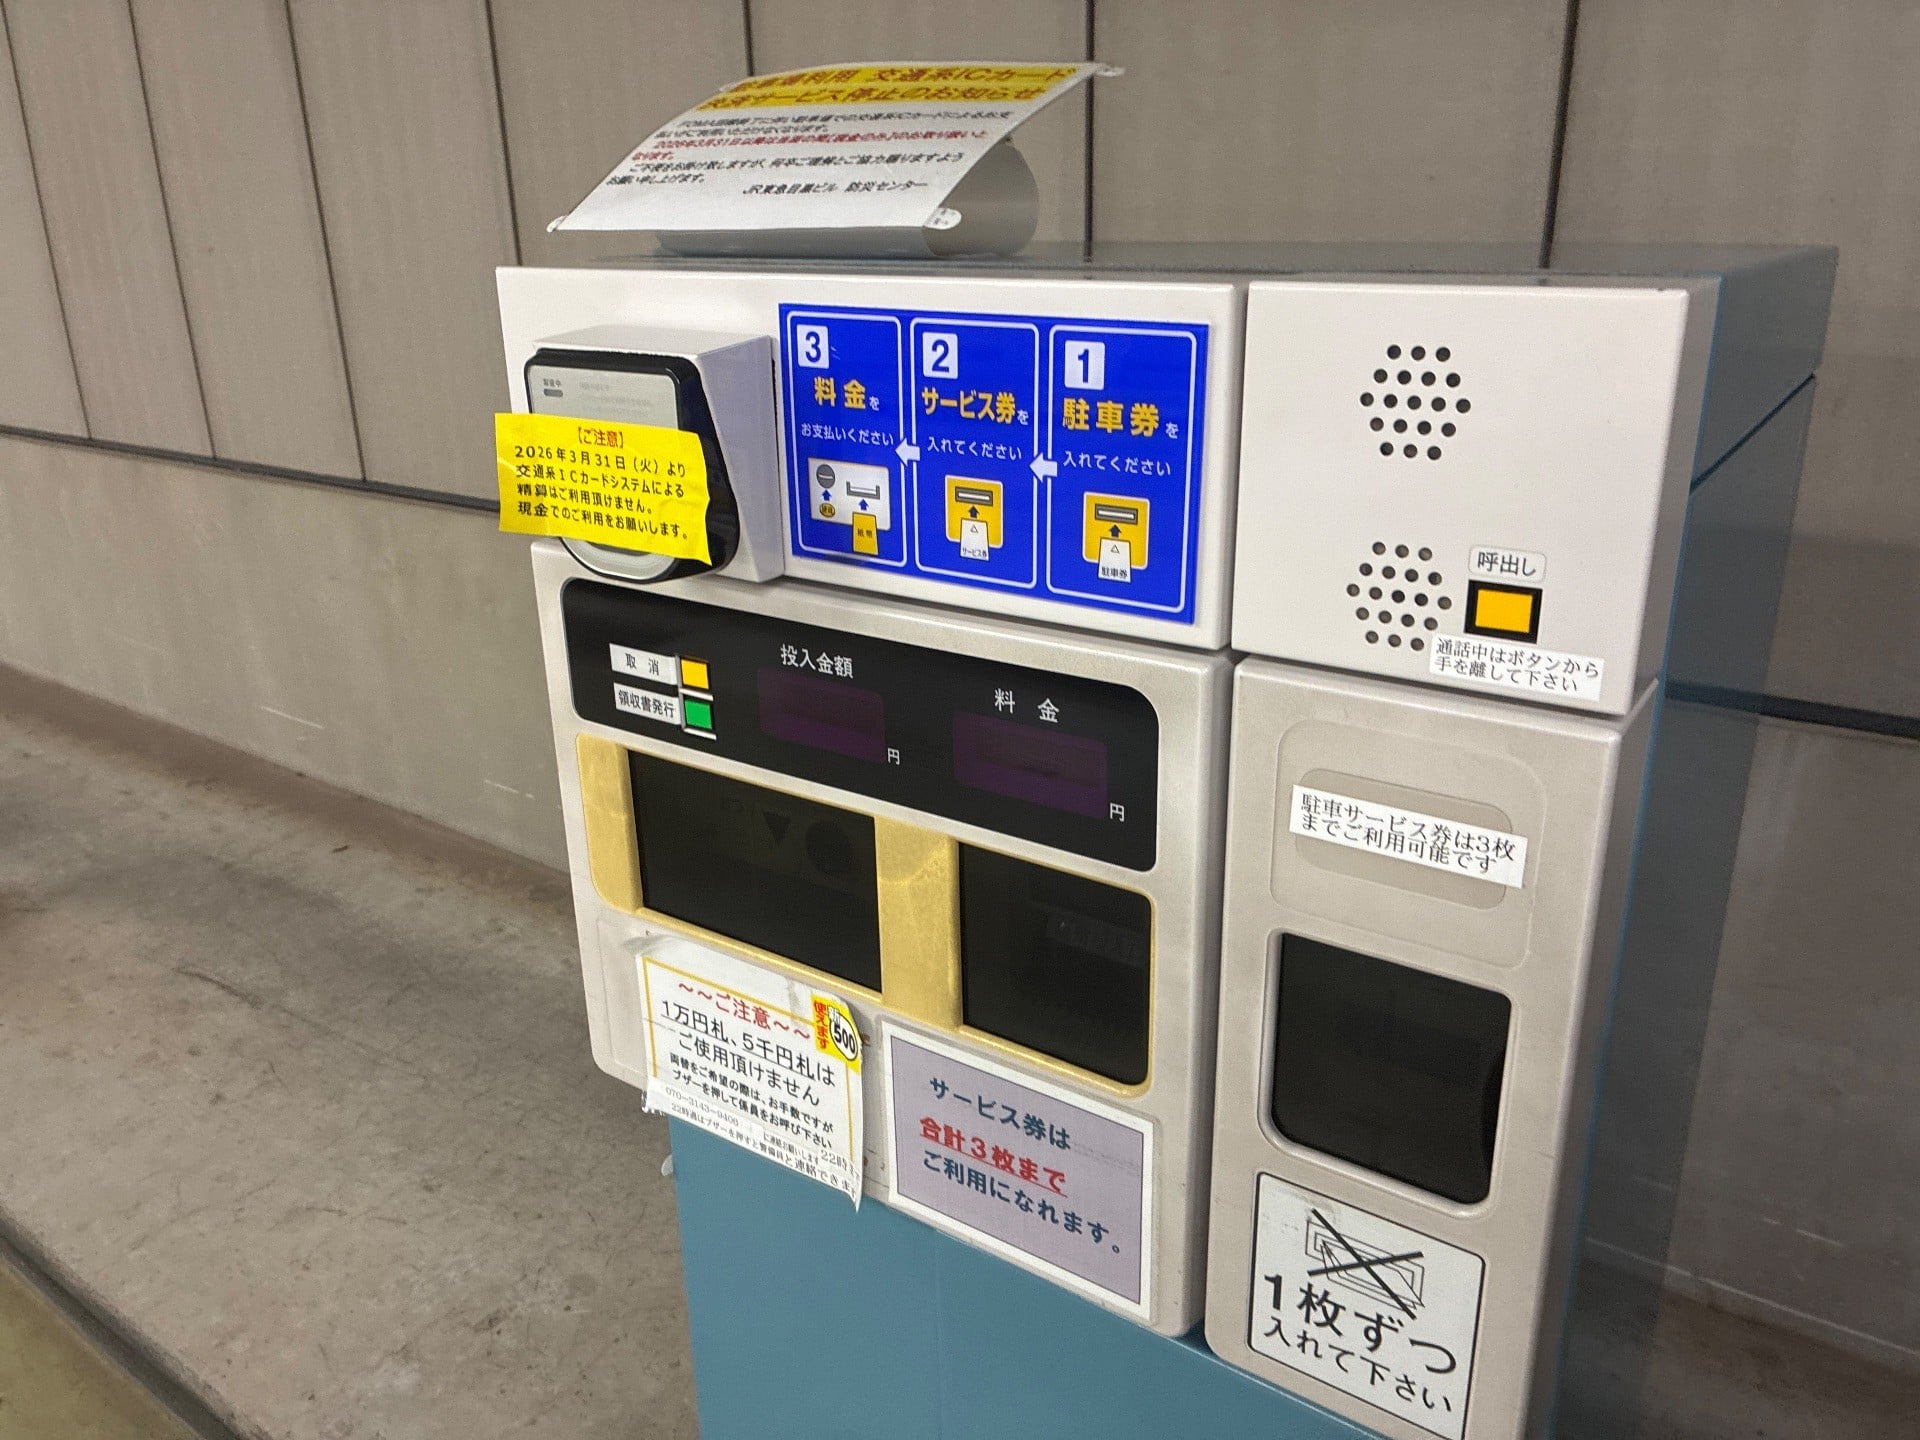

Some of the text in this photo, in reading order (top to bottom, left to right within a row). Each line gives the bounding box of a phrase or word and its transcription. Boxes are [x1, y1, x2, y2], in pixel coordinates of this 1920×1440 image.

[844, 180, 930, 194] 防災センター
[804, 329, 823, 363] 3
[931, 338, 950, 374] 2
[1076, 348, 1092, 384] 1
[920, 385, 1030, 426] サービス券を
[1062, 398, 1179, 440] 駐車券を
[577, 426, 625, 449] 【ご注意】
[800, 422, 895, 447] お支払いください
[927, 436, 1023, 461] 入れてください
[515, 463, 685, 498] 交通系ICカードシステムによる
[1062, 450, 1172, 477] 入れてください
[517, 482, 653, 515] 精算はご利用頂けません。
[517, 501, 688, 540] 現金でのご利用をお願いします。
[1477, 551, 1537, 577] 呼出し
[780, 643, 855, 680] 投入金額
[1434, 656, 1579, 693] 手を離して下さい
[1436, 637, 1600, 679] 通話中はボタンから
[618, 689, 675, 718] 領収書発行
[887, 747, 901, 765] 円
[1109, 802, 1126, 823] 円
[1300, 792, 1516, 862] 駐車サービス券は3枚
[1301, 812, 1497, 875] までご利用可能です
[660, 999, 836, 1088] 1万円札、5千円札は
[833, 1022, 857, 1055] 500
[678, 1032, 820, 1107] ご使用頂けません
[670, 1052, 834, 1135] 両替をご希望の際は、お手数ですが
[673, 1068, 833, 1150] ブザーを押して係員をお呼び下さい
[929, 1076, 1071, 1151] サービス券は
[919, 1116, 1067, 1194] 合計3枚まで
[923, 1149, 1121, 1254] ご利用になれます。
[1264, 1273, 1457, 1374] 1枚ずつ
[1263, 1315, 1452, 1413] 入れて下さい
